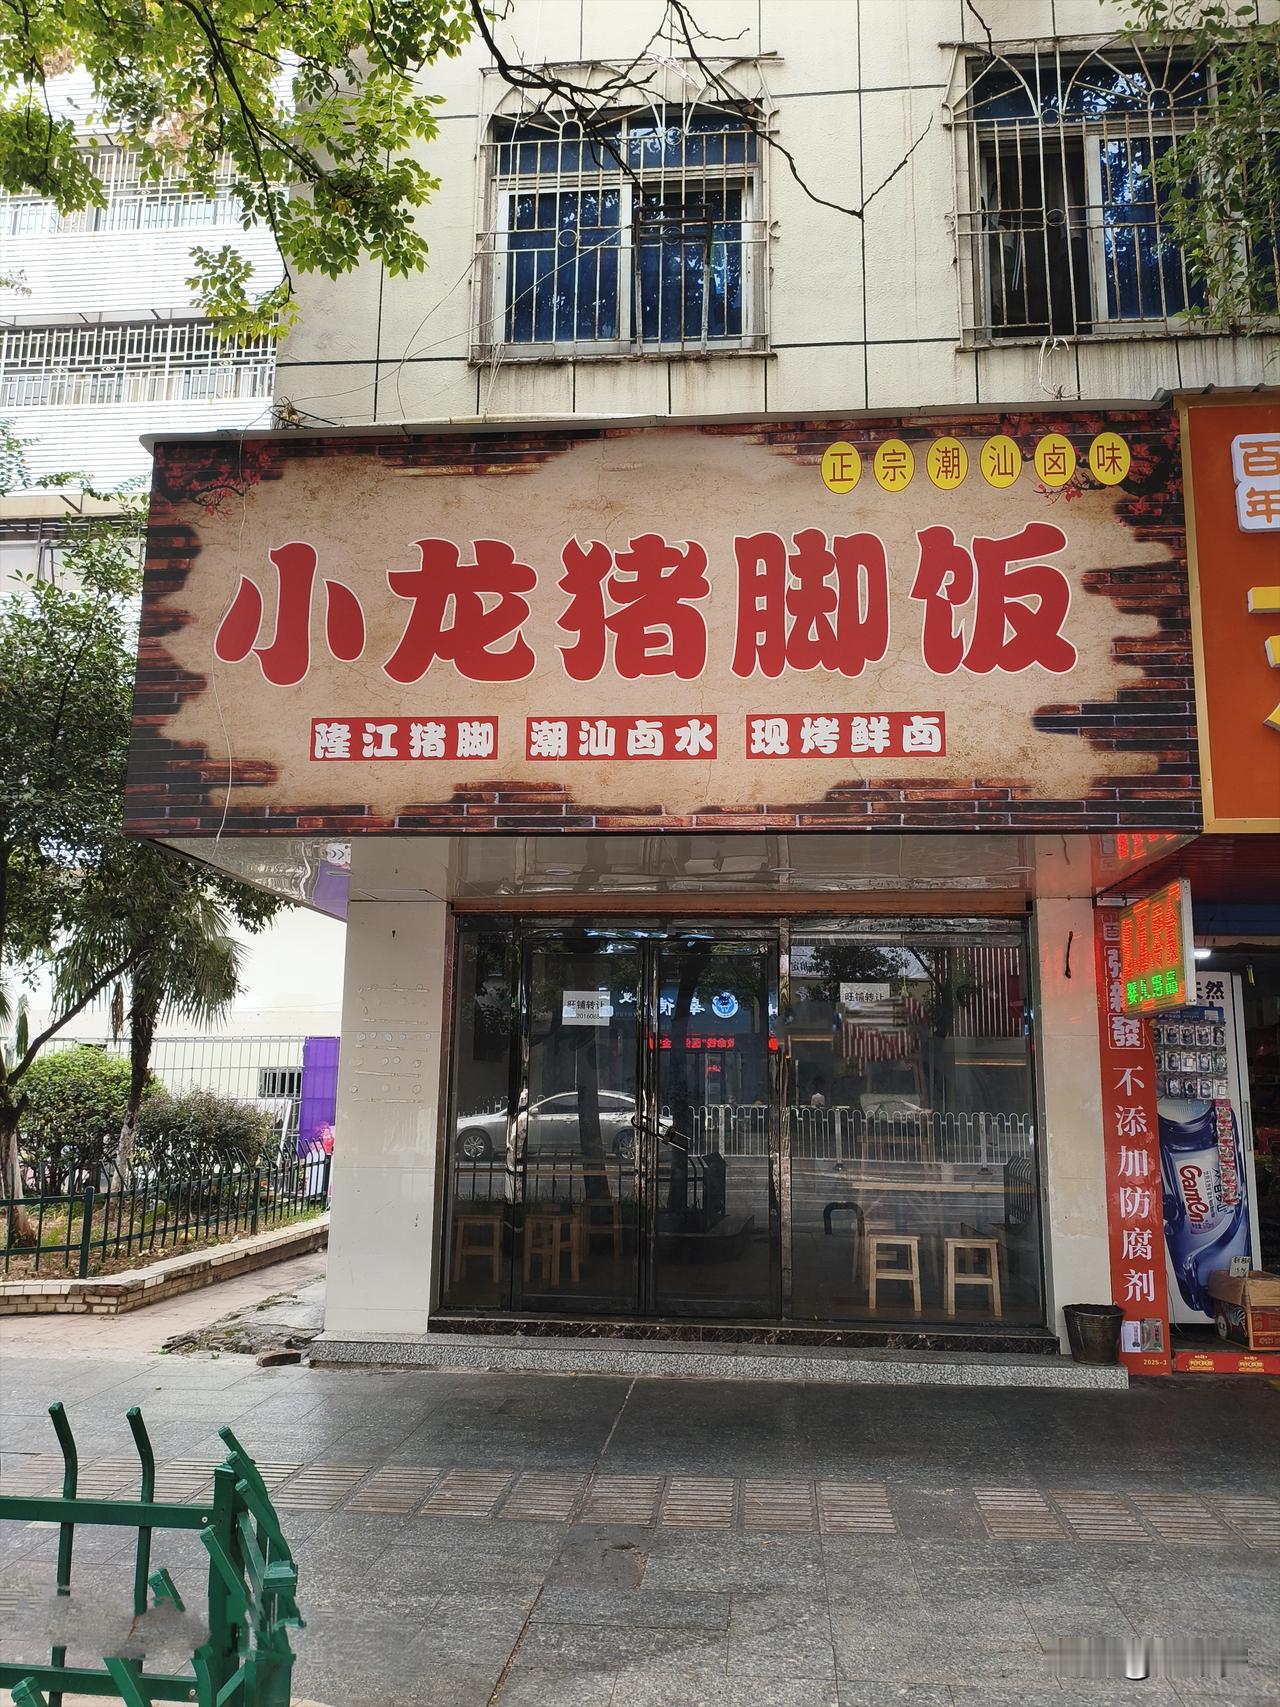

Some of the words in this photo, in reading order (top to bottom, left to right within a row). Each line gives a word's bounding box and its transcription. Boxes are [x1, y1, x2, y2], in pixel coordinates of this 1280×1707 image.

[828, 440, 1124, 484] 正宗潮汕卤味
[213, 520, 1078, 687] 小龙猪脚饭
[313, 721, 495, 758] 隆江猪脚
[530, 719, 715, 759] 潮汕卤水
[750, 716, 943, 756] 现烤鲜卤
[1112, 1065, 1155, 1303] 不添加防腐剂
